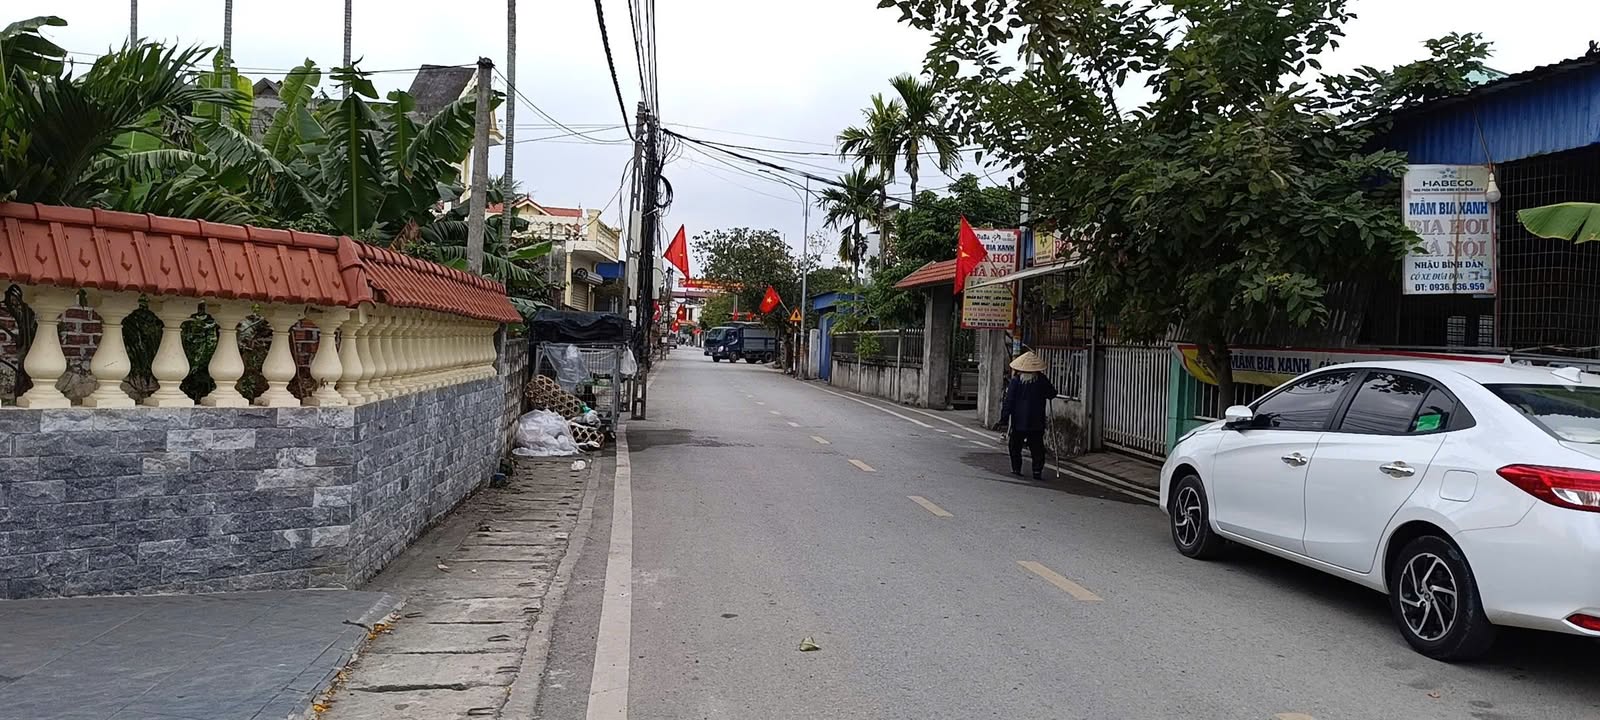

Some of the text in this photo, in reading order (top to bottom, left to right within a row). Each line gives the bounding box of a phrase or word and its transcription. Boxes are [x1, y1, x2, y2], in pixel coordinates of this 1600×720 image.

[1439, 202, 1456, 215] BIA
[1460, 202, 1488, 215] XANH
[1408, 219, 1445, 235] BIA
[998, 244, 1015, 252] XANH
[1446, 238, 1486, 259] NỘI
[1414, 260, 1440, 270] NHẬU
[1257, 356, 1274, 370] BIA
[1278, 357, 1311, 372] XANH
